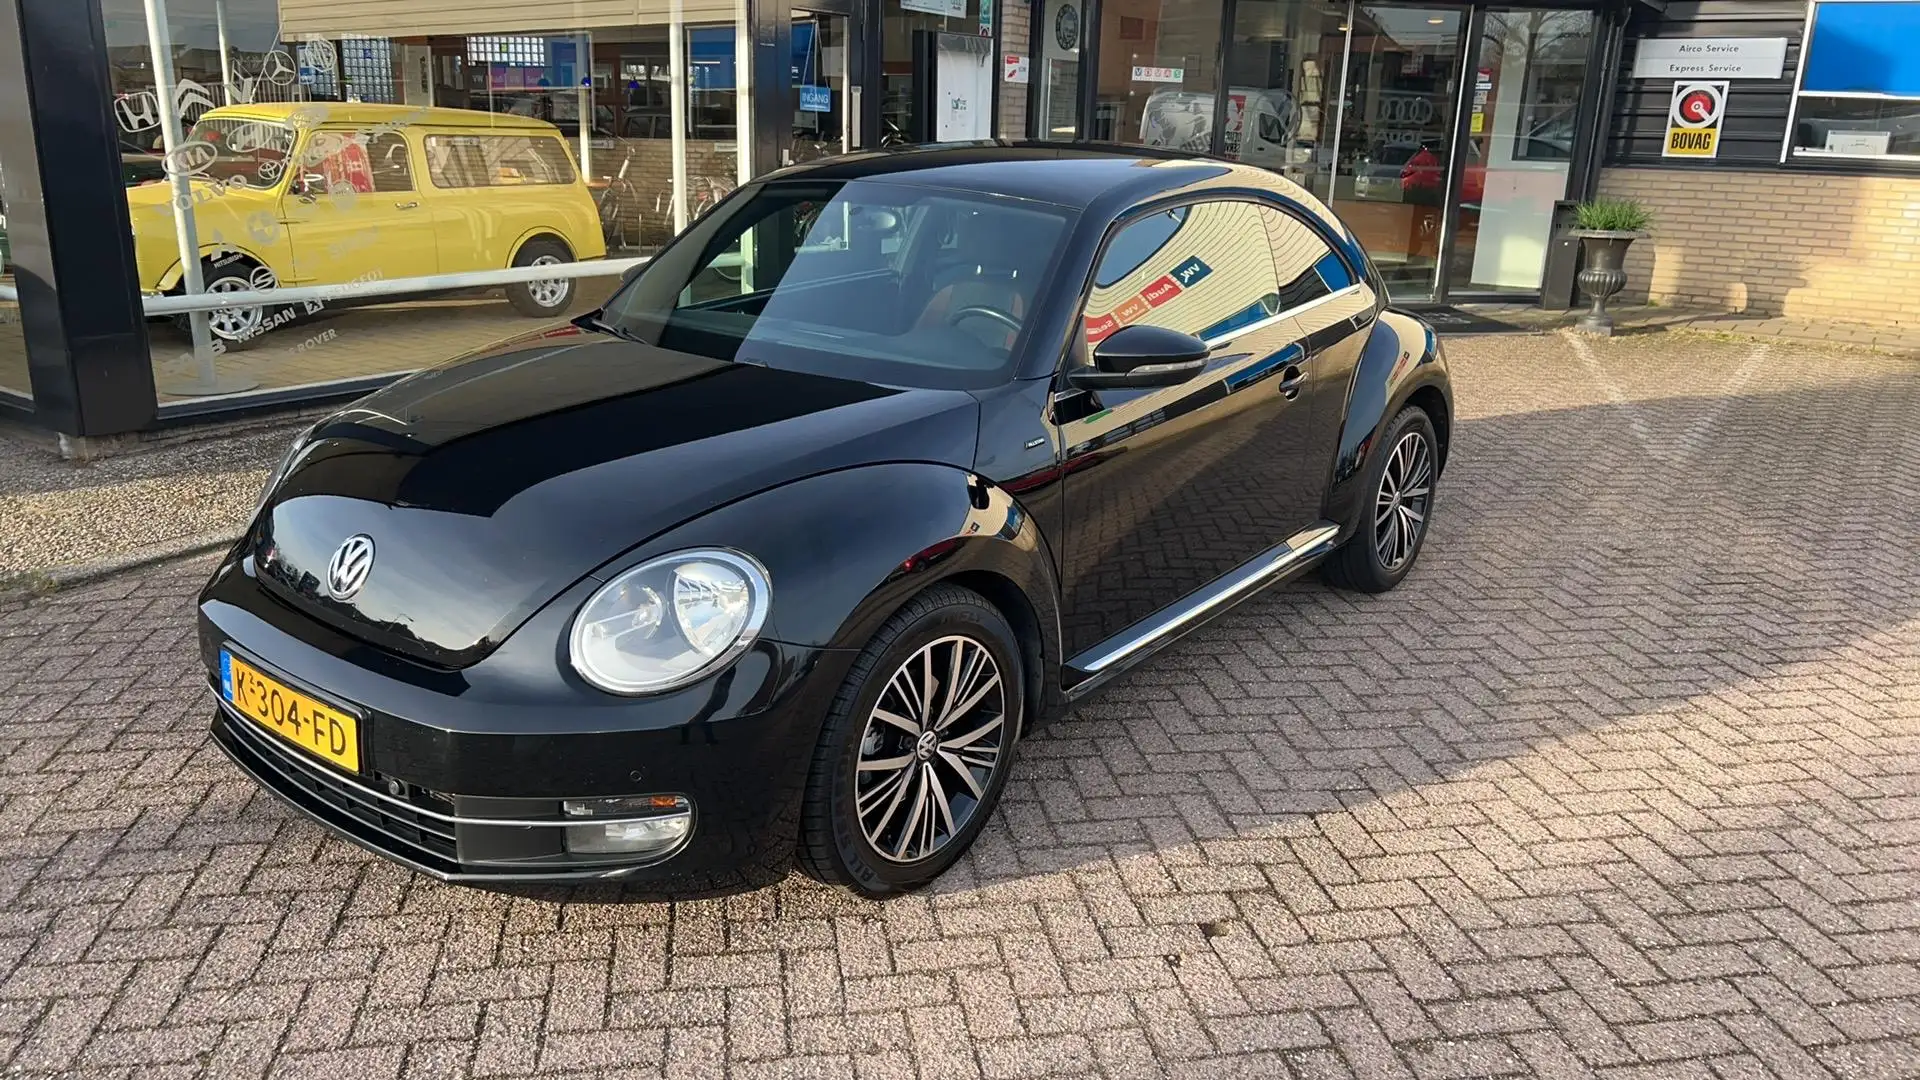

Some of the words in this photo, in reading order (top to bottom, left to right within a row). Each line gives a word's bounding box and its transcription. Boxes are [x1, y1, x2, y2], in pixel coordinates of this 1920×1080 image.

[1678, 45, 1703, 53] Airco
[1705, 45, 1740, 53] Service
[1669, 64, 1705, 73] Express
[1708, 64, 1742, 73] Service
[1671, 132, 1711, 149] BOVAG
[171, 144, 213, 171] KIA
[236, 306, 297, 344] NISSAN
[296, 328, 338, 353] ROVER
